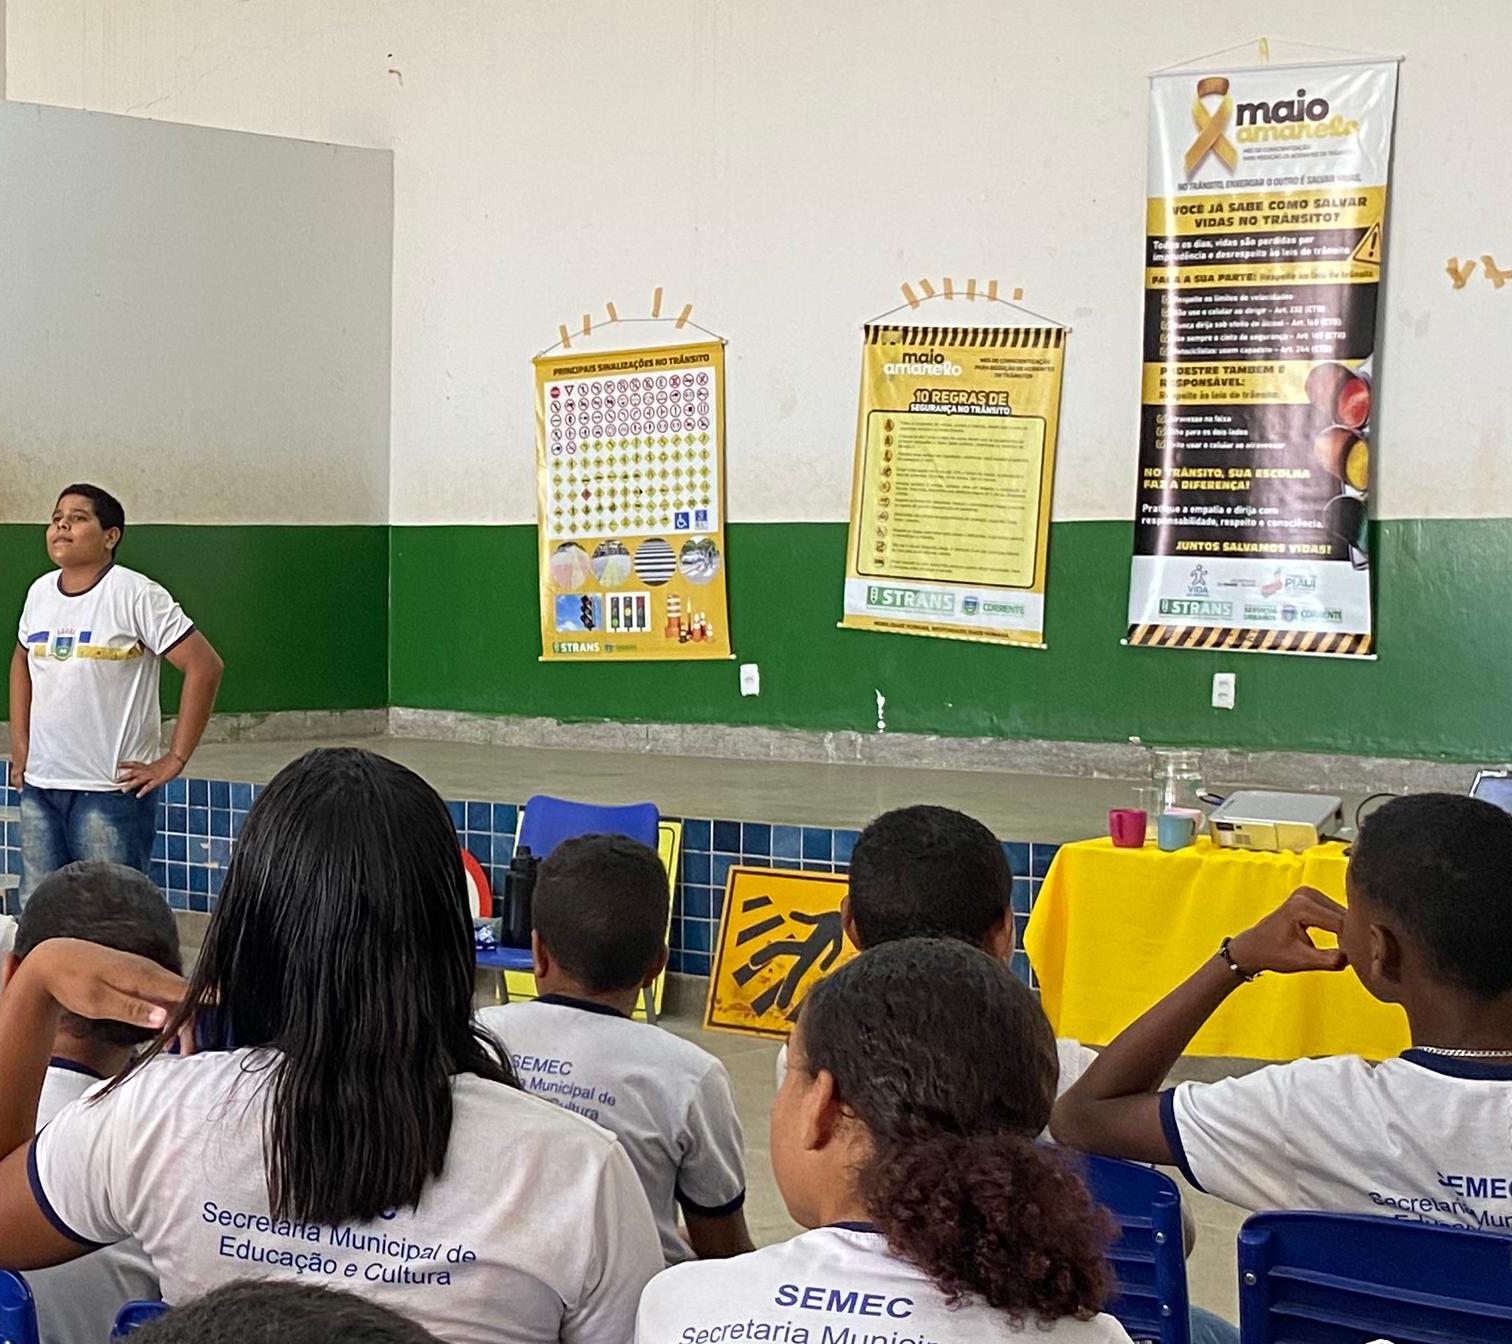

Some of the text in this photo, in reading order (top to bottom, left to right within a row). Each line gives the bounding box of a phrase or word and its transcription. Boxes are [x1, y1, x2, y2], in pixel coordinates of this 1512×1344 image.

[1236, 89, 1329, 126] maio
[1173, 197, 1368, 215] VOCÊ JÁ SABE COMO SALVAR
[1195, 212, 1340, 228] VIDAS NO TRÂNSITO?
[1152, 275, 1180, 284] FAA
[1194, 273, 1215, 282] SUA
[1218, 272, 1257, 282] PARTE:
[553, 364, 596, 376] PRINCIPAIS
[655, 358, 667, 366] NO
[669, 354, 710, 365] TRÂNSITO
[903, 349, 944, 365] maio
[883, 362, 963, 377] amarelo
[1160, 366, 1219, 376] PDESTRE
[1160, 377, 1245, 386] RSPONSÁVEL:
[915, 390, 1008, 406] 10 REGRAS DE
[911, 404, 1010, 415] SEGURANÇA NO TRÂNSITO
[1144, 468, 1161, 477] NO
[1229, 468, 1252, 478] SUA
[1169, 481, 1179, 489] A
[1181, 480, 1250, 491] DIFERENÇA!
[1176, 541, 1332, 554] JUNTOS SALVAMOS VIDAS!
[1188, 586, 1208, 594] VIDA
[882, 590, 953, 610] STRANS
[1171, 601, 1231, 616] STRANS
[561, 642, 600, 652] STRANS
[511, 1054, 573, 1076] SEMEC
[530, 1077, 595, 1100] Municipal
[598, 1092, 616, 1106] de
[1437, 1171, 1512, 1199] EME
[202, 1201, 476, 1264] Secretaria Municipal de
[218, 1235, 451, 1286] Educação e Cultura
[774, 1283, 914, 1320] SEMEC
